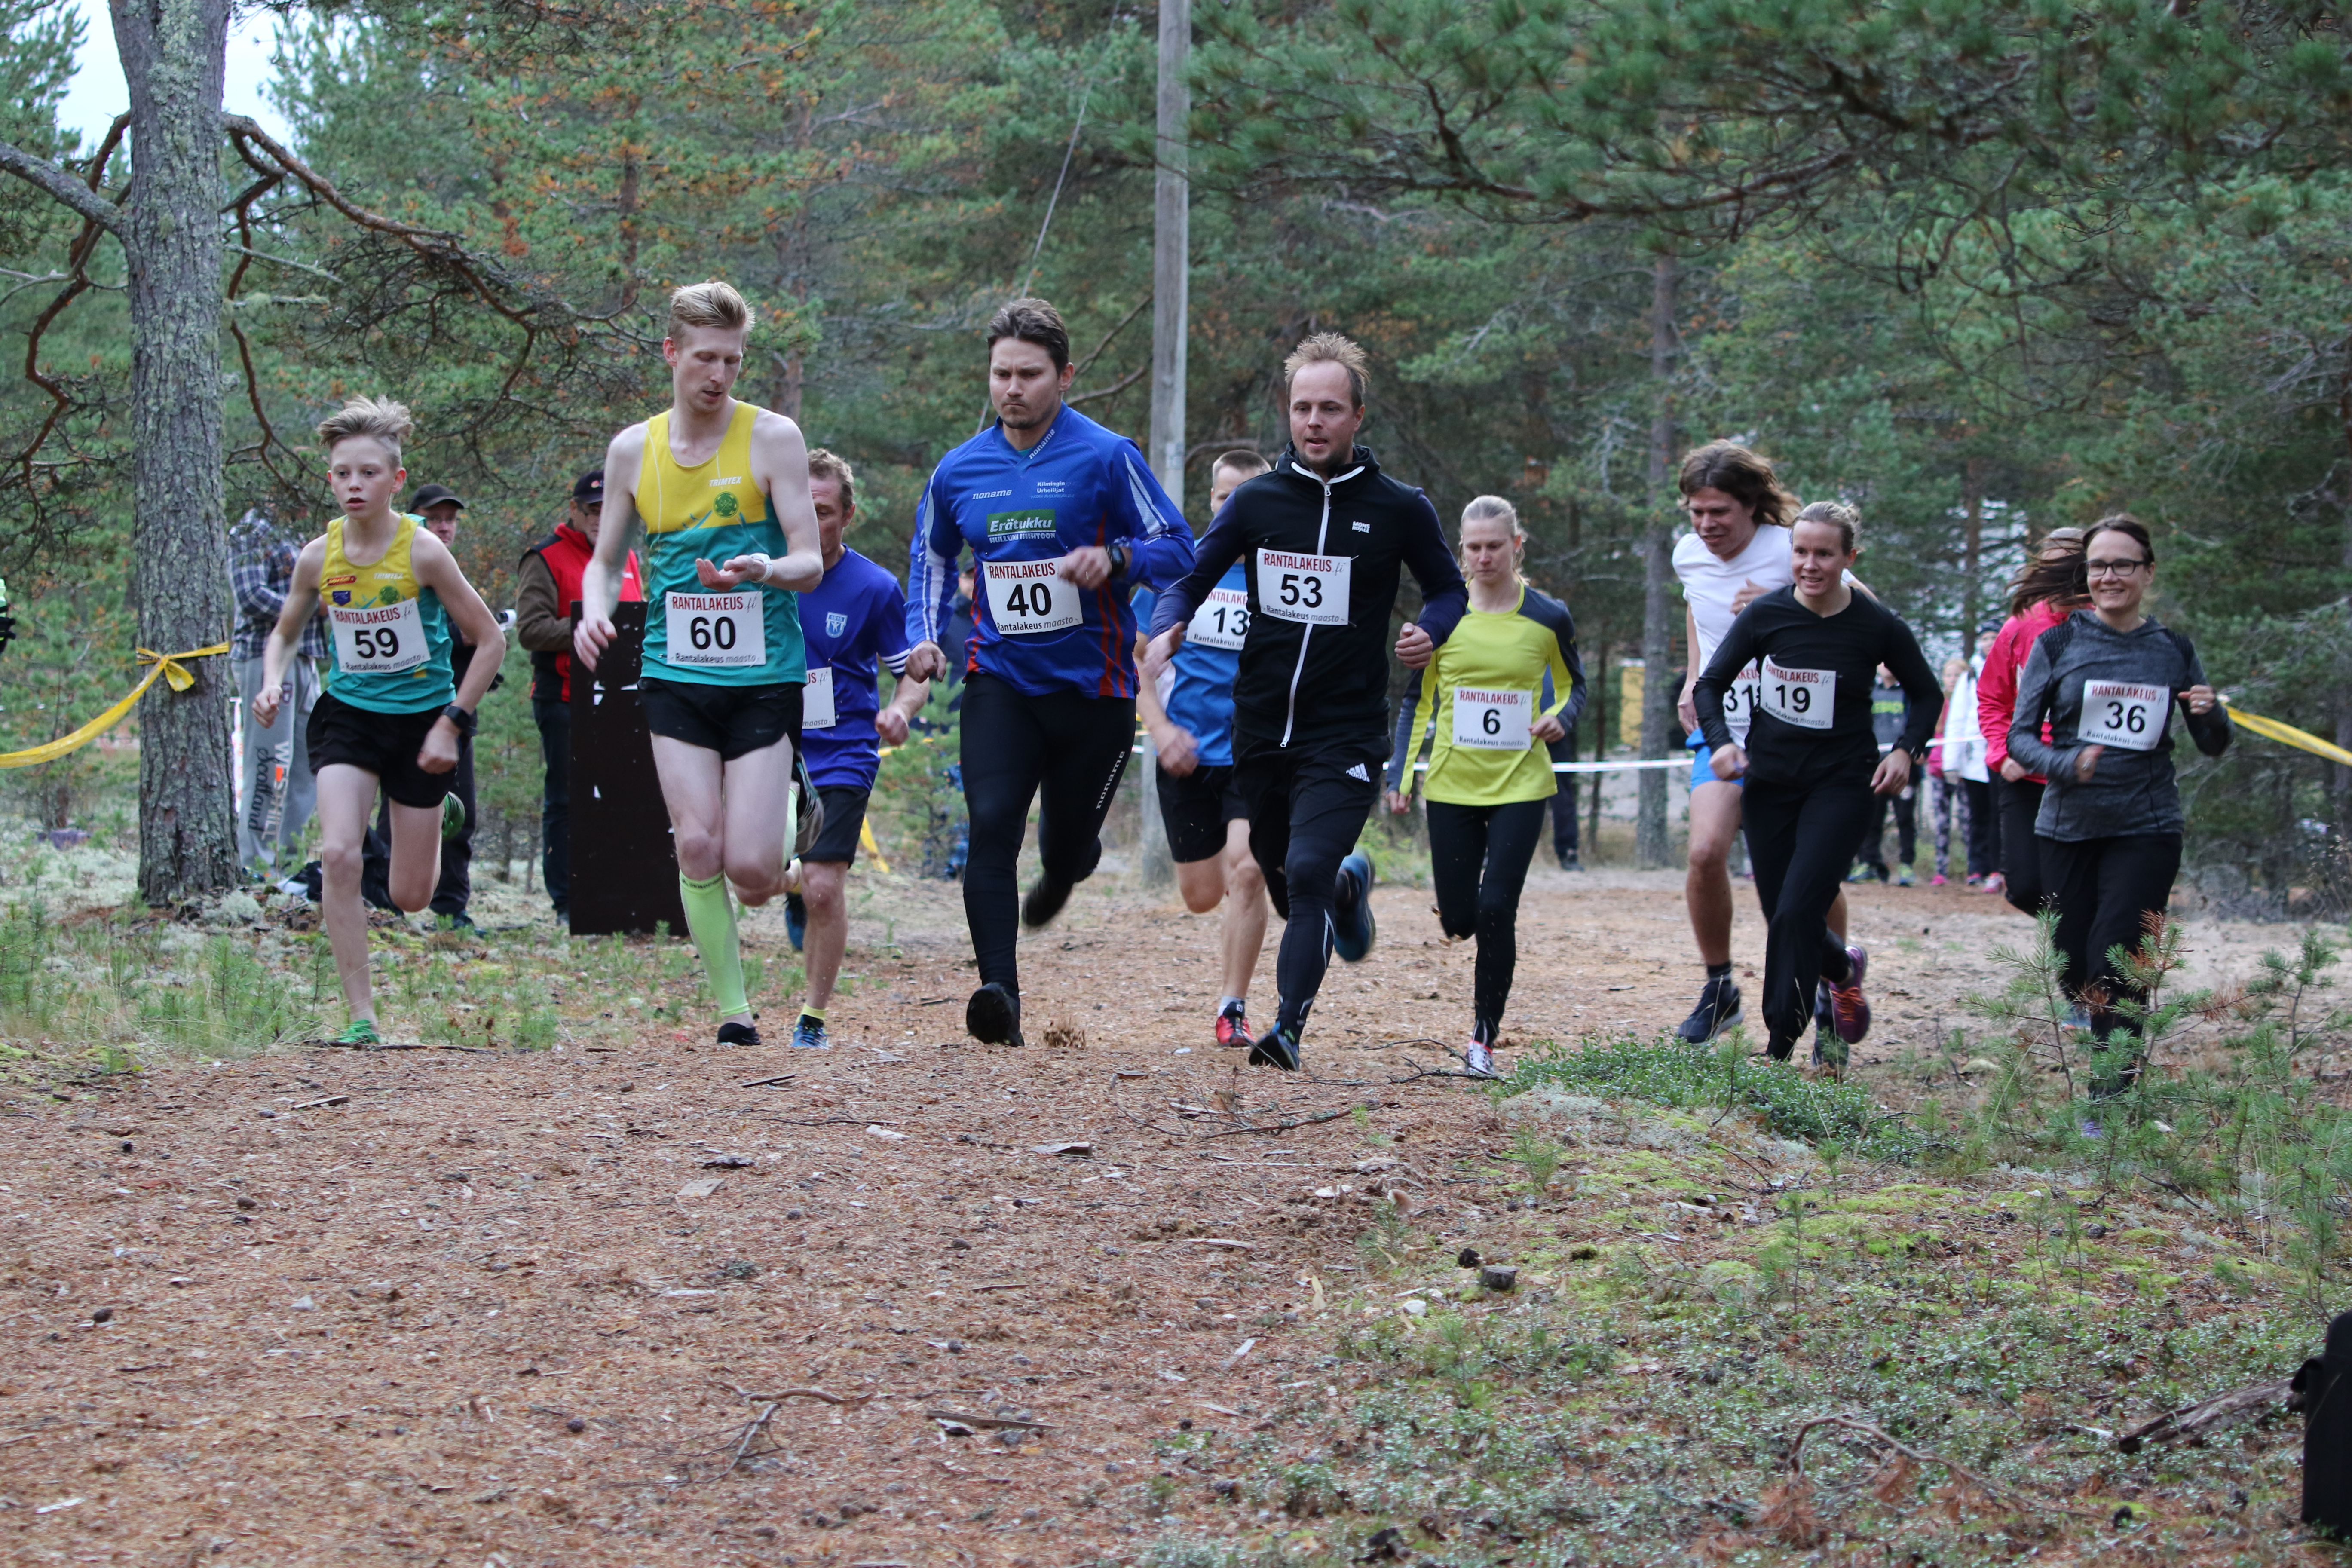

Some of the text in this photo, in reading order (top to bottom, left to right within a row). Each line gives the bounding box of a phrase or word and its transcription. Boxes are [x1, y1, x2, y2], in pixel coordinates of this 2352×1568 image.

[709, 476, 742, 487] TRIMTEX
[972, 490, 1012, 500] noname
[990, 517, 1052, 533] Erätukku
[1353, 521, 1370, 529] MONS
[989, 562, 1056, 579] RANTALAKEUS
[1264, 553, 1332, 572] RANTALAKEUS
[1280, 574, 1322, 608] 53
[672, 596, 744, 611] RANTALAKEUS
[1007, 583, 1052, 617] 40
[333, 607, 401, 625] RANTALAKEUS
[1213, 606, 1249, 636] 13
[1267, 605, 1309, 620] Rantalakeus
[997, 616, 1074, 631] Rantalakeus maasto
[690, 616, 736, 651] 60
[1194, 634, 1235, 647] Rantalakeus
[355, 628, 399, 659] 59
[346, 654, 421, 671] Rantalakeus maasto
[675, 653, 756, 664] Rantalakeus maasto
[1766, 661, 1819, 683] RANTALAKEUS
[1460, 690, 1518, 705] RANTALAKEUS
[1725, 685, 1754, 712] 31
[1775, 684, 1811, 713] 19
[2092, 685, 2156, 701] RANTALAKEUS
[803, 719, 828, 727] maasto
[1483, 709, 1501, 735] 6
[2105, 701, 2146, 733] 36
[1459, 735, 1499, 747] Rantalakeus
[1096, 751, 1125, 809] noname
[1346, 769, 1370, 782] adidas
